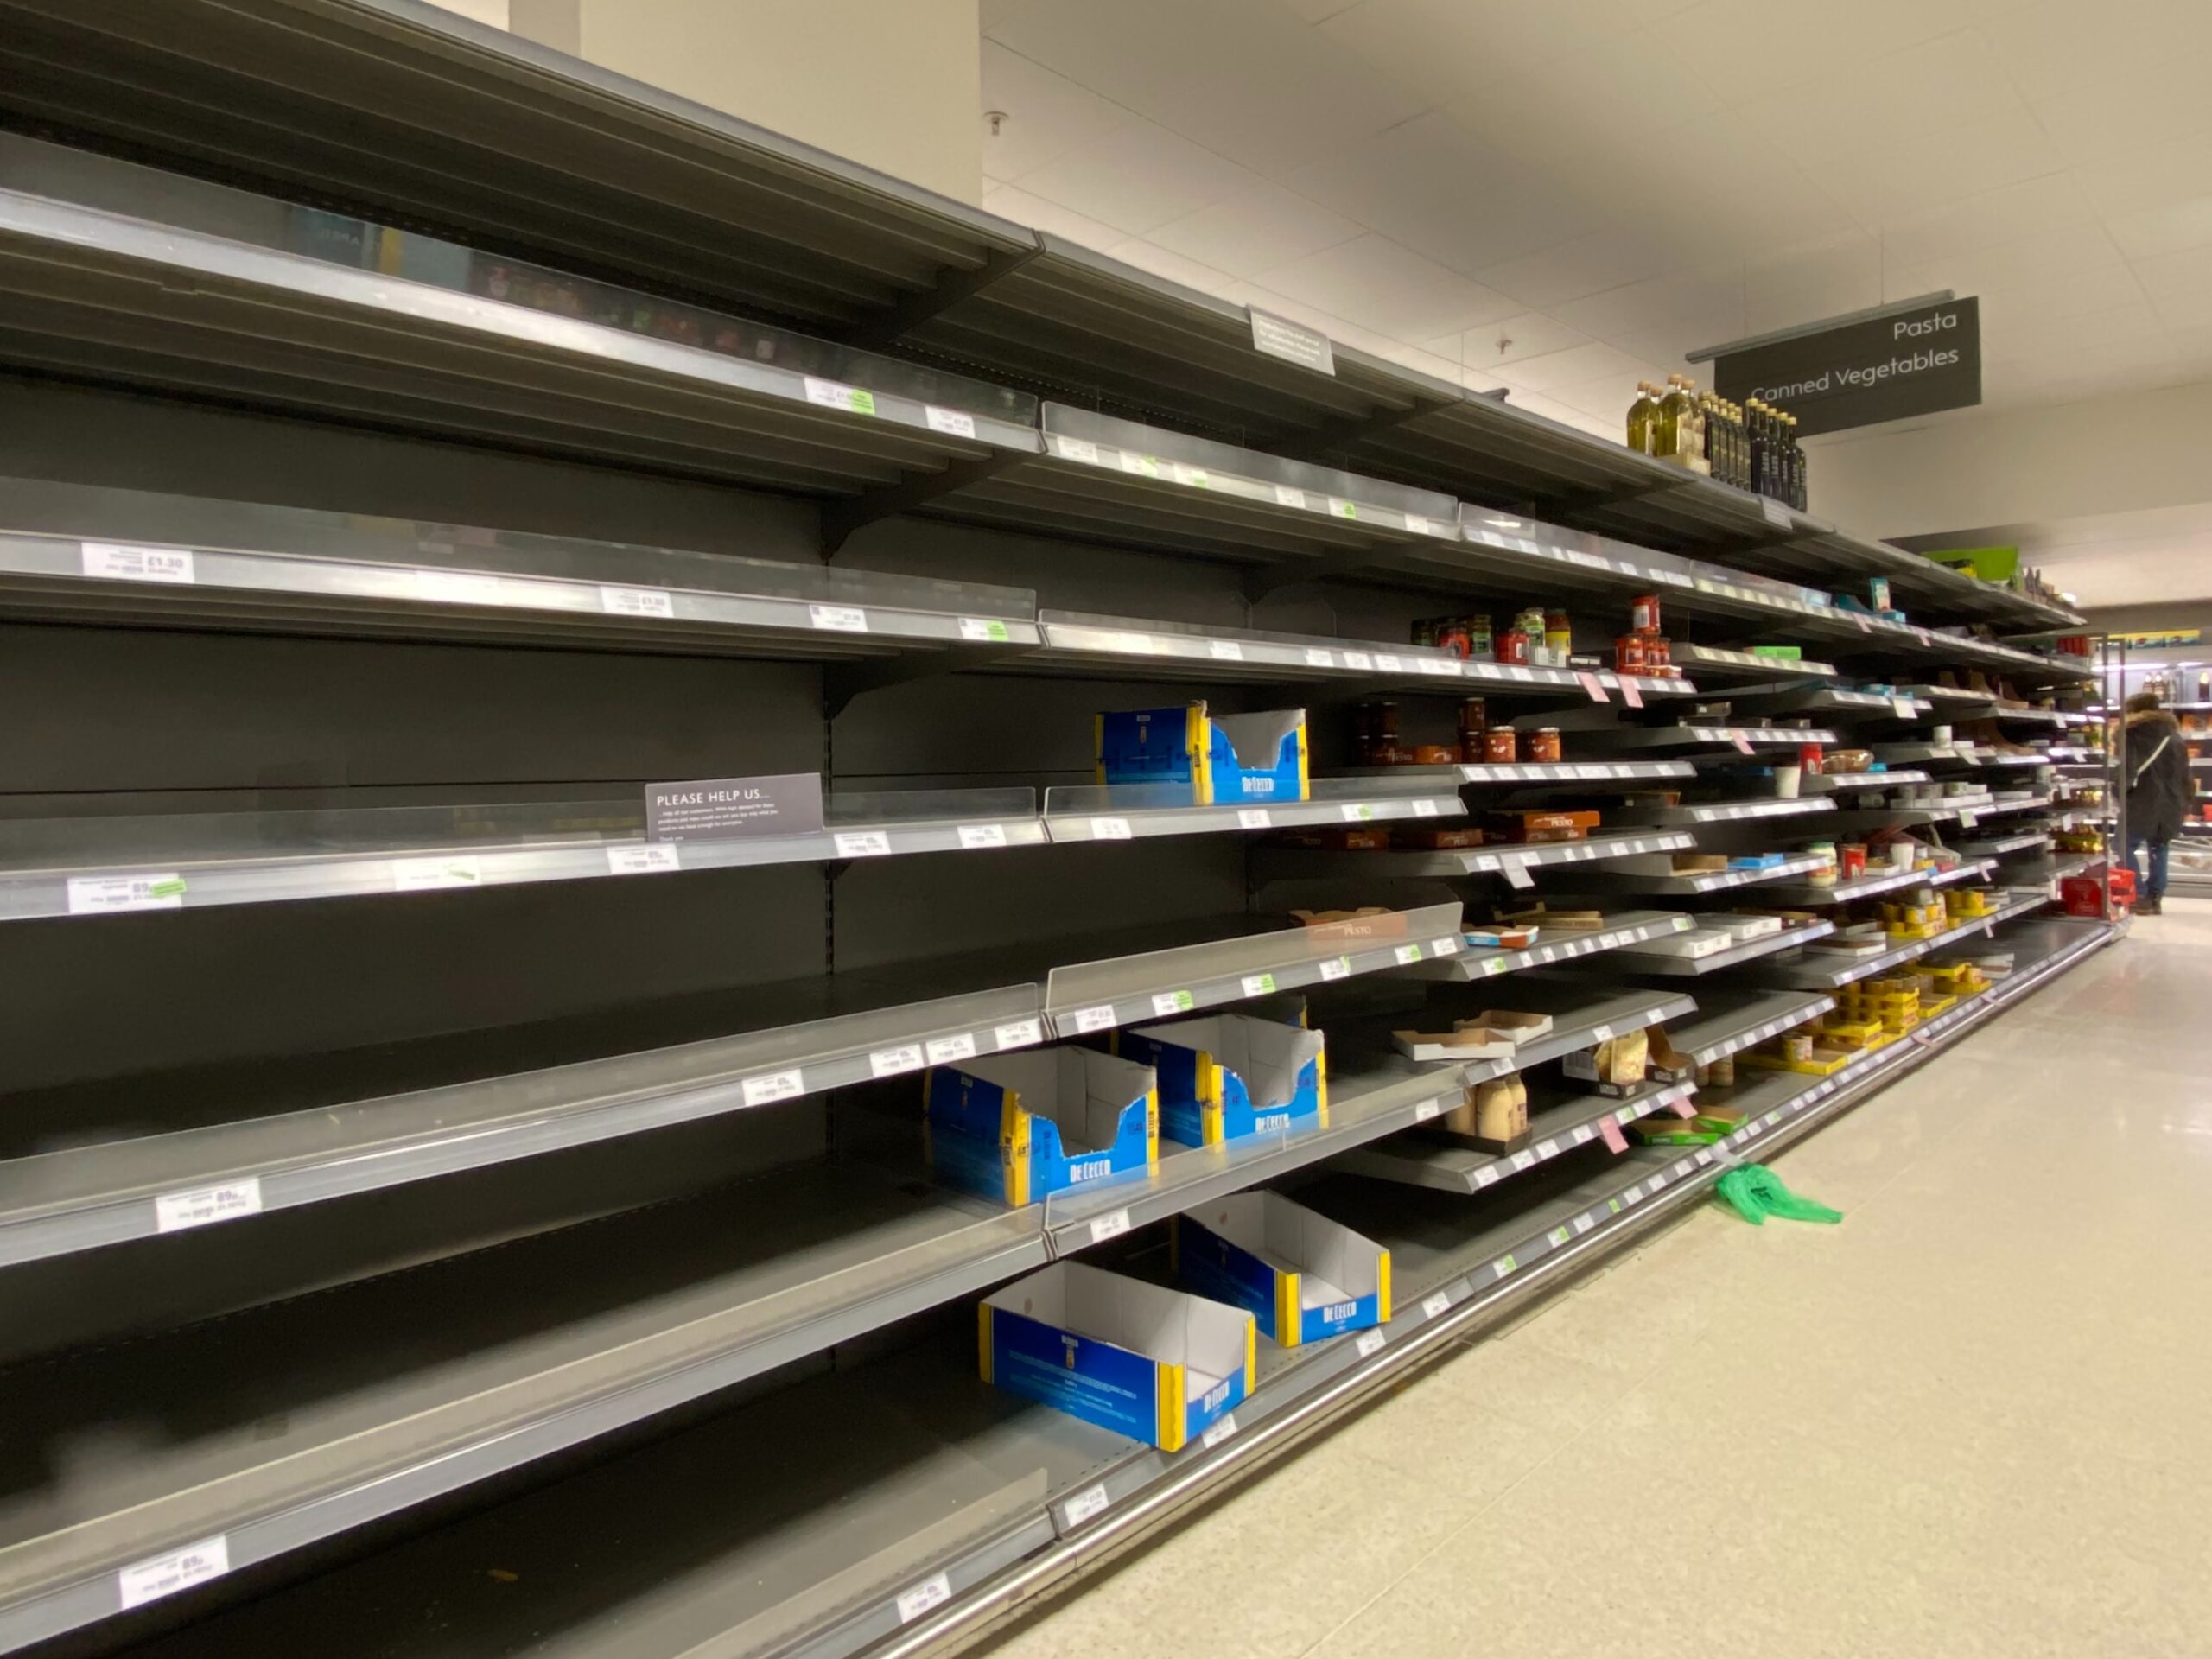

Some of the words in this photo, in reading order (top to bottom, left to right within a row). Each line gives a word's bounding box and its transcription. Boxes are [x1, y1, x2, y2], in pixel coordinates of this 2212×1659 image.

[1894, 313, 1957, 340] Pasta
[1751, 372, 1829, 403] Canned
[1835, 349, 1960, 387] Vegetables
[148, 556, 183, 569] £1.30
[657, 792, 703, 807] PLEASE
[709, 790, 740, 804] HELP
